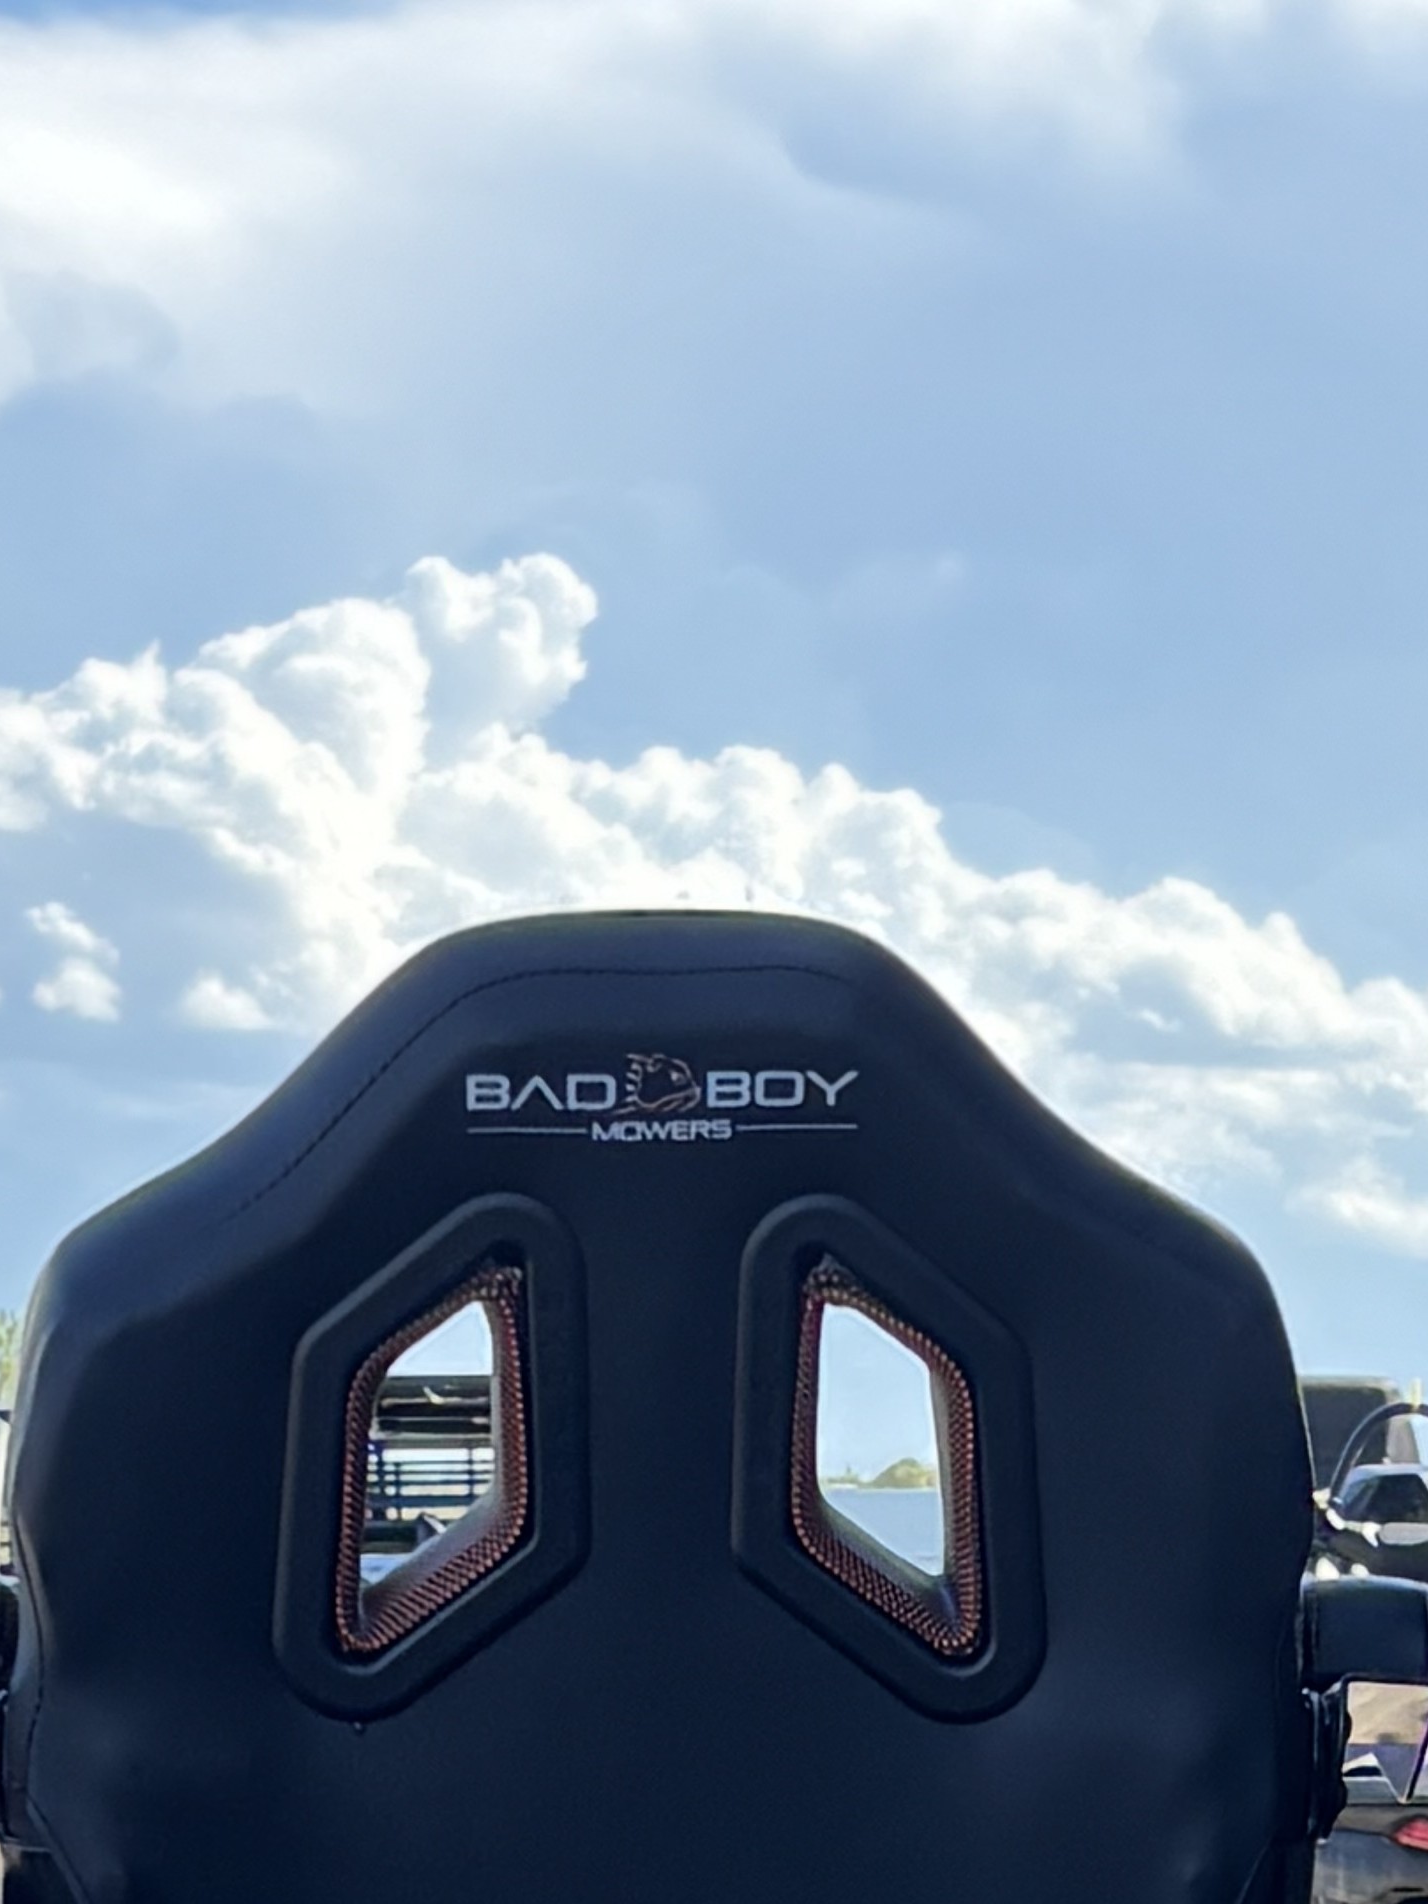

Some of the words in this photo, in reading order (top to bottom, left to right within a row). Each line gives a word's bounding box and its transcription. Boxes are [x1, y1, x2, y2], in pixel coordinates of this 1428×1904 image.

[465, 1074, 617, 1112] BAD
[706, 1070, 860, 1108] BOY
[590, 1118, 733, 1142] MOWERS
